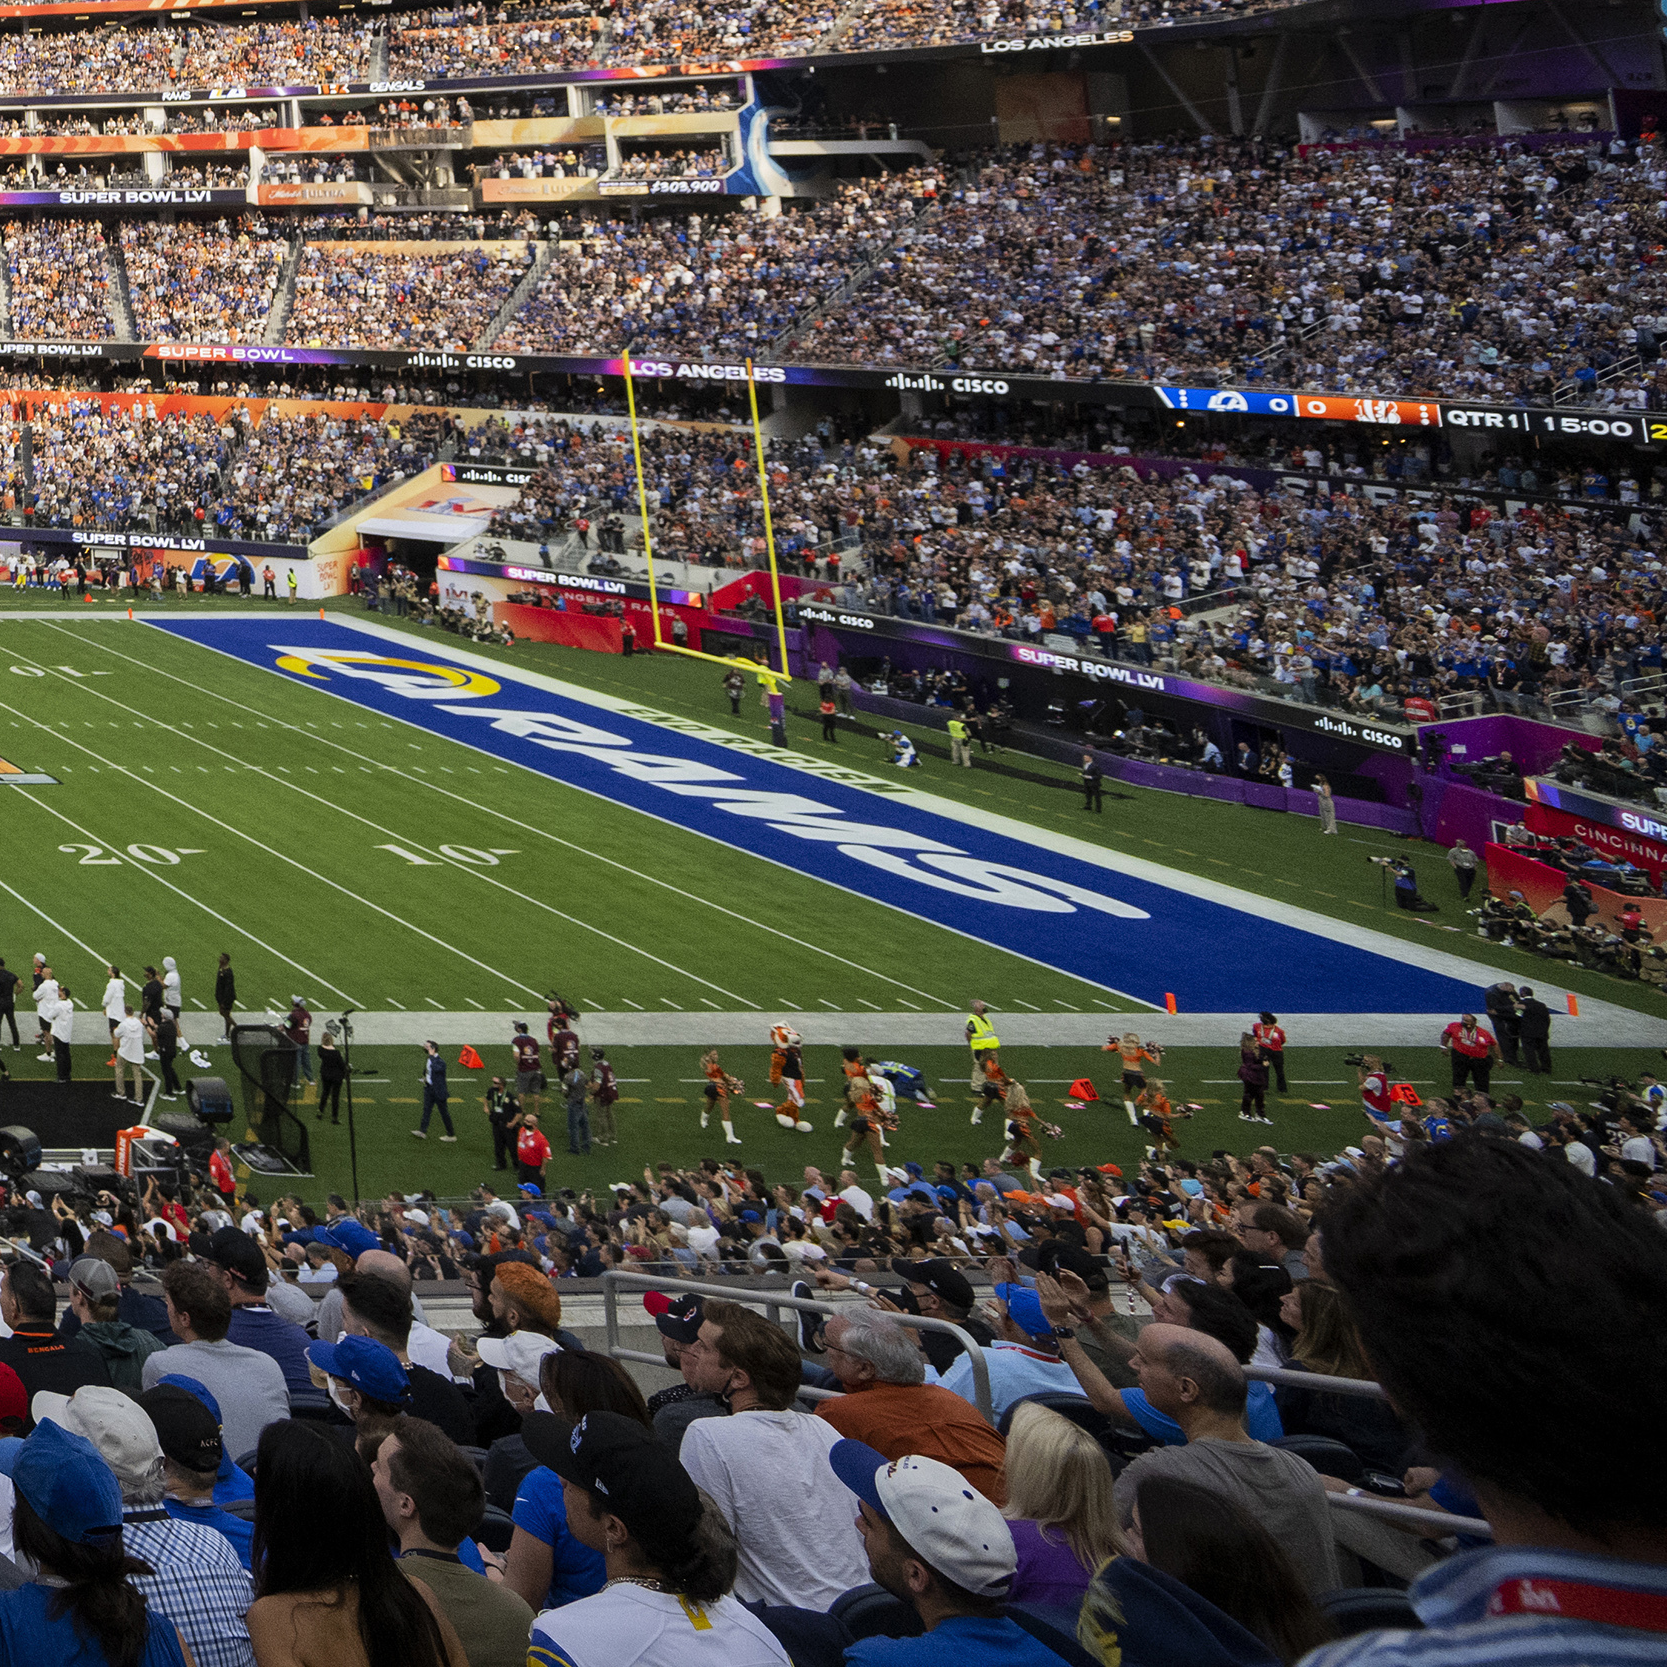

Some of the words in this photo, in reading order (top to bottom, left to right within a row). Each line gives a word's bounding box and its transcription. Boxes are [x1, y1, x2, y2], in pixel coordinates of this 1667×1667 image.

[981, 39, 1027, 53] LOS
[1027, 30, 1135, 51] ANGELES
[369, 80, 426, 93] BENGALS
[59, 191, 122, 205] SUPER
[125, 190, 184, 204] BOWL
[184, 189, 212, 204] LVI
[158, 345, 227, 359] SUPER
[233, 346, 295, 361] BOWL
[465, 354, 516, 370] CISCO
[628, 360, 674, 377] LOS
[675, 363, 787, 383] ANGELES
[951, 378, 1010, 395] CISCO
[1269, 397, 1289, 411] 0
[1307, 400, 1327, 415] 0
[1543, 415, 1633, 437] 15:00
[72, 531, 127, 546] SUPER
[129, 534, 181, 549] BOWL
[180, 537, 206, 551] LVI
[507, 566, 557, 585] SUPER
[558, 575, 603, 591] BOWL
[599, 580, 626, 595] LVI
[838, 614, 875, 630] CISCO
[1017, 647, 1080, 673] SUPER
[1080, 659, 1136, 687] BOWL
[1135, 671, 1165, 691] LVI
[1361, 728, 1403, 749] CISCO
[435, 702, 1152, 920] RAMS
[58, 843, 181, 865] 20
[372, 843, 500, 866] 10
[26, 1343, 67, 1355] BENGALS
